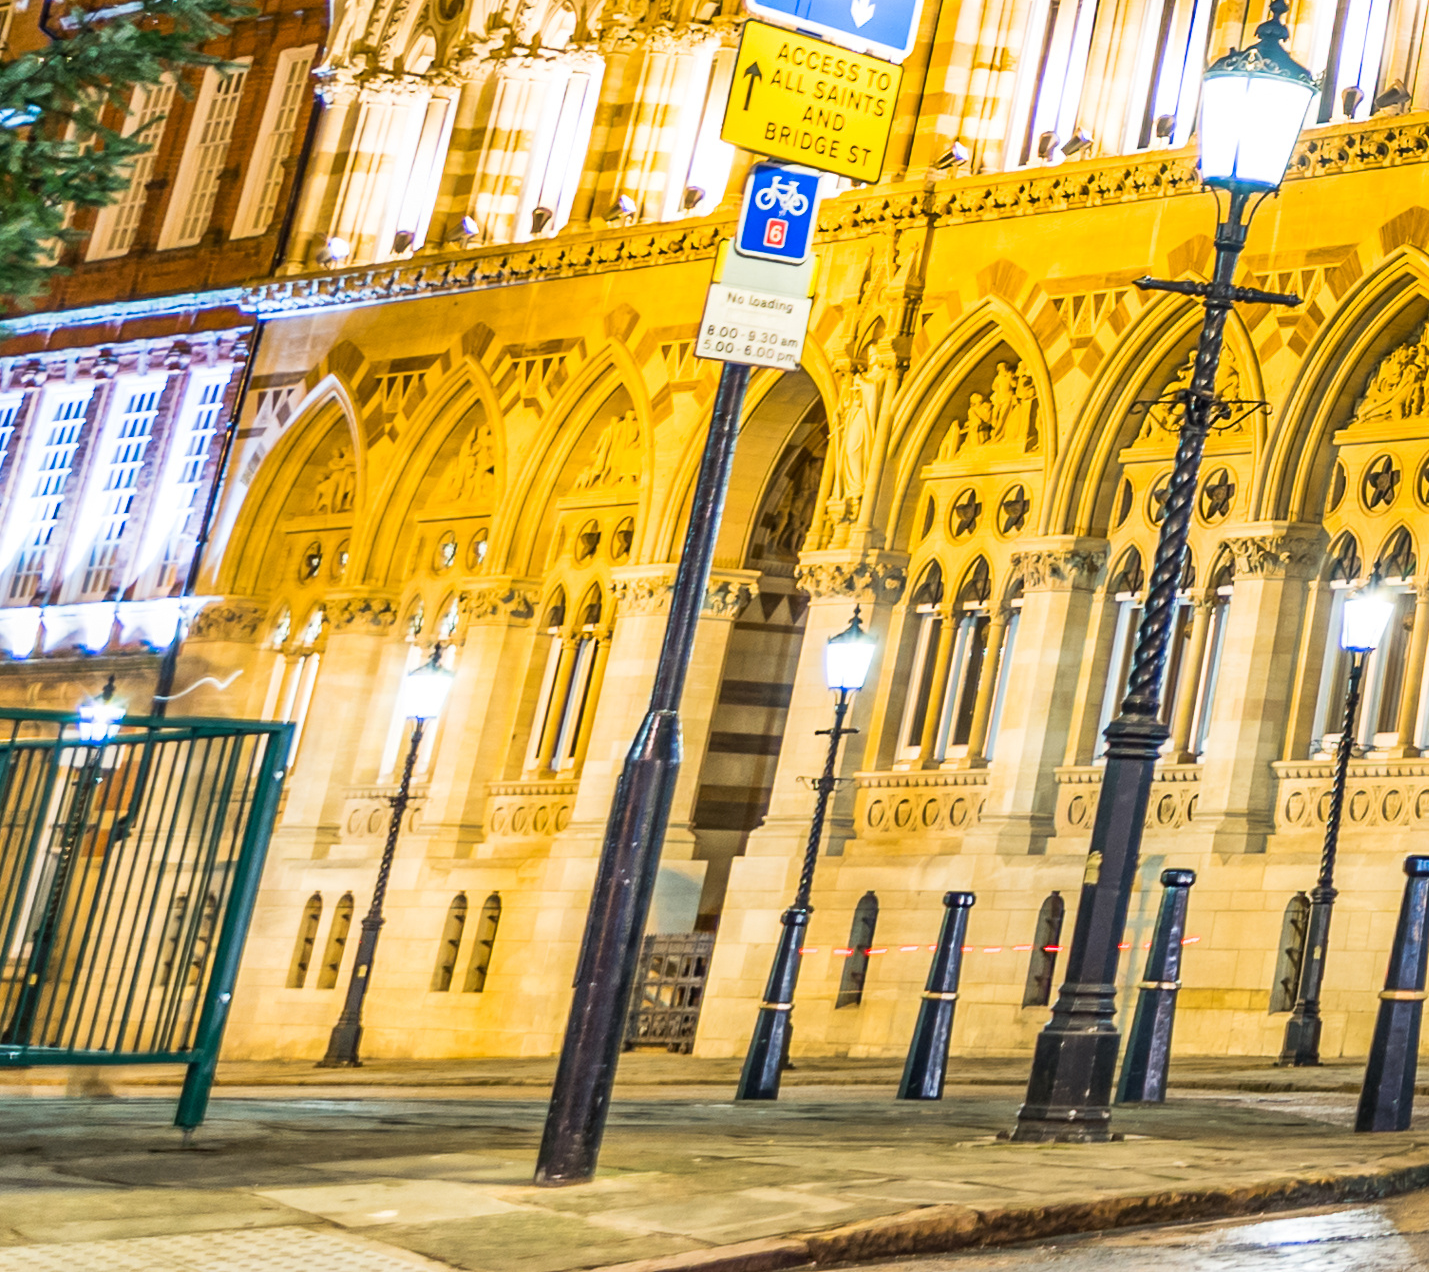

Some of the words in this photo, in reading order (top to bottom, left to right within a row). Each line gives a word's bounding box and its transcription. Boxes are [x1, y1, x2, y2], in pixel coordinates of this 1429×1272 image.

[776, 43, 861, 82] ACCESS
[867, 68, 892, 91] TO
[769, 68, 805, 94] ALL
[813, 80, 886, 117] SAINTS
[801, 106, 845, 132] AND
[764, 121, 841, 159] BRIDGE
[847, 145, 872, 166] ST
[769, 224, 783, 243] 6
[727, 292, 745, 305] No
[780, 337, 799, 348] am
[776, 352, 796, 363] pm
